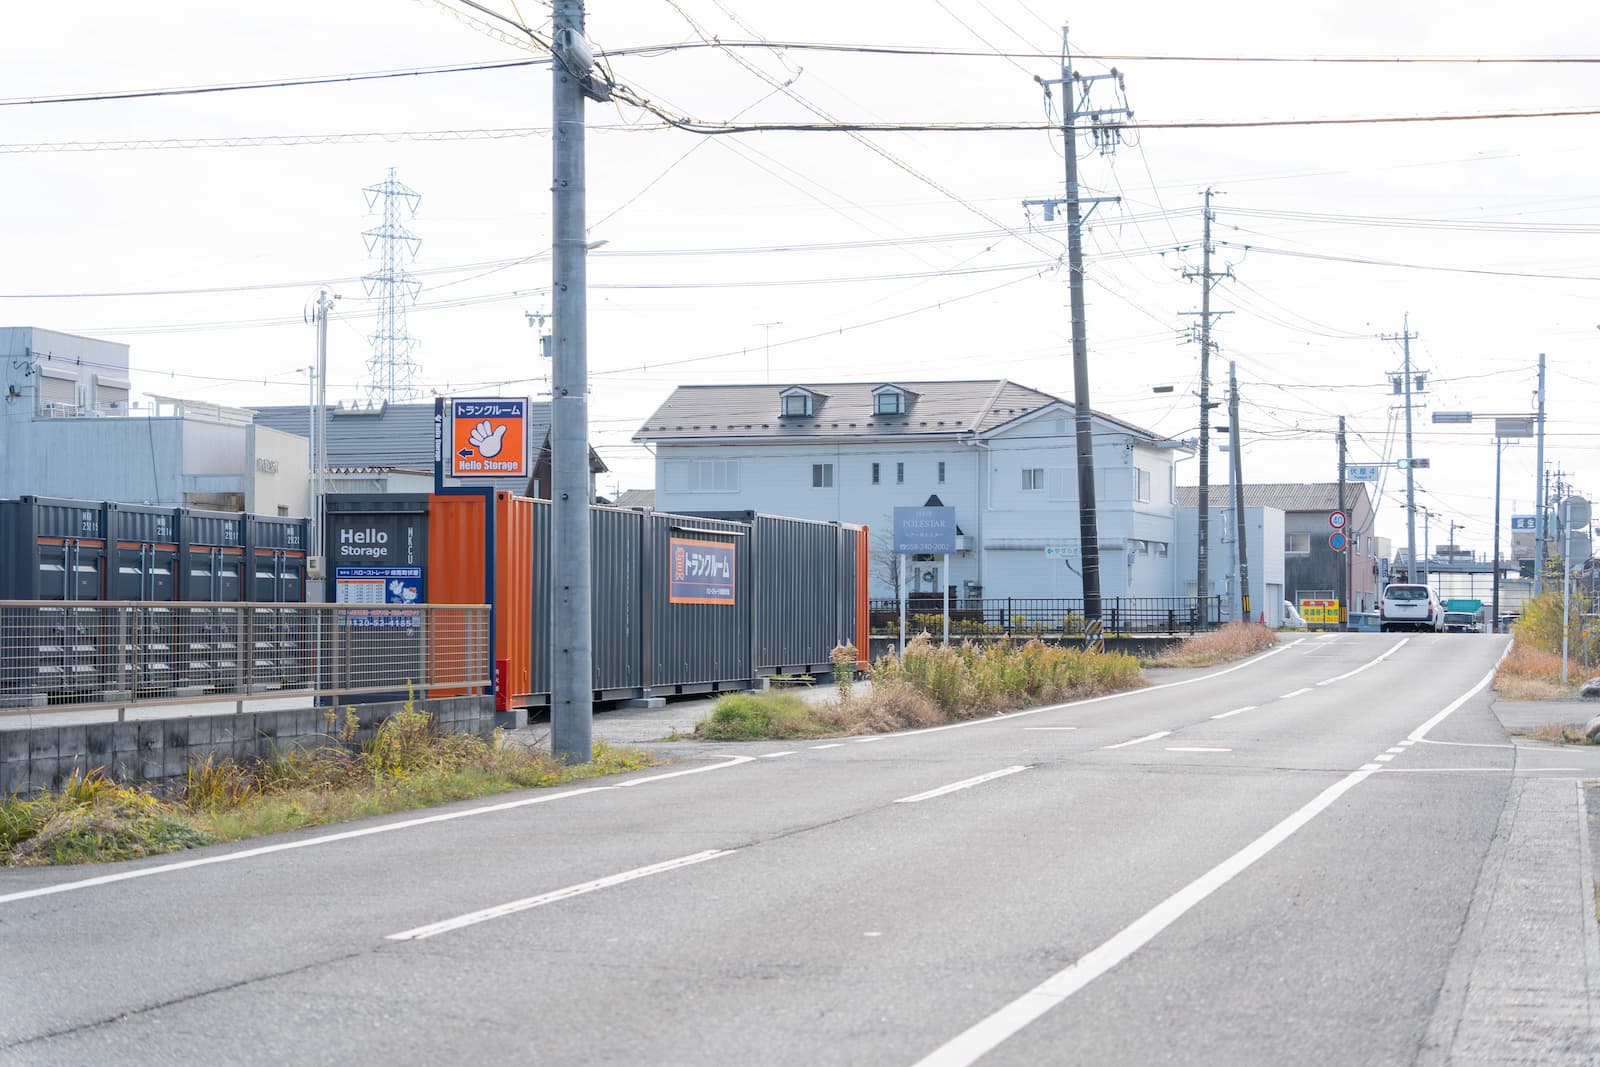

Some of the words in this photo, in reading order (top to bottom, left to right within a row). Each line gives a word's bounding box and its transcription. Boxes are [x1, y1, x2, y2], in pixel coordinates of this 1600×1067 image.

[458, 405, 520, 416] トランクルーム
[459, 460, 482, 470] Hello
[484, 460, 519, 471] Storage
[903, 520, 945, 528] POLESTAR
[1333, 516, 1343, 525] 40
[340, 528, 388, 544] Hello
[340, 545, 388, 558] Storage
